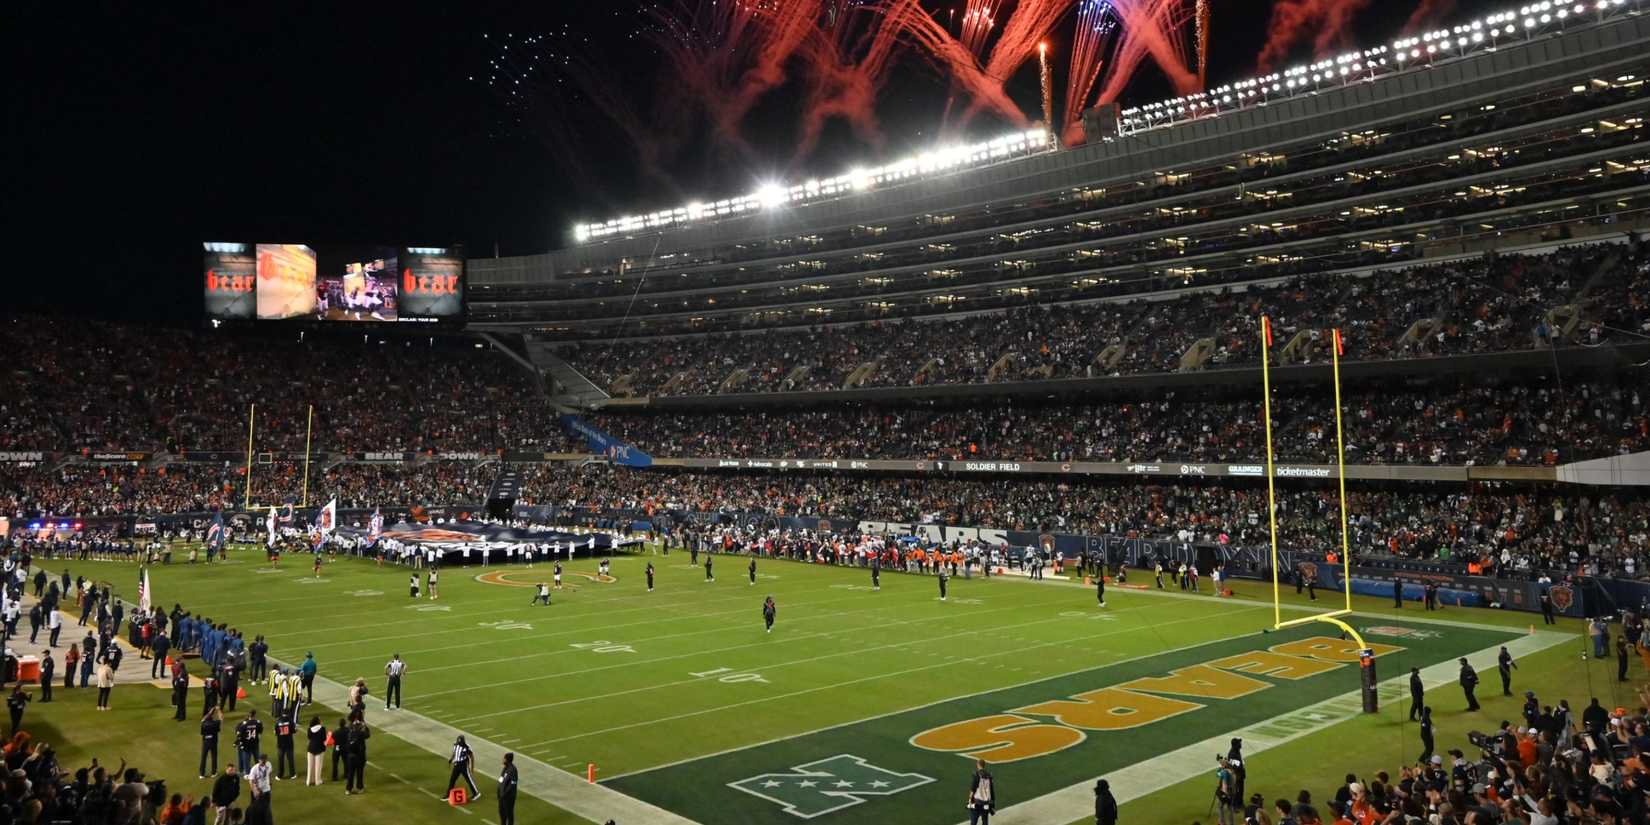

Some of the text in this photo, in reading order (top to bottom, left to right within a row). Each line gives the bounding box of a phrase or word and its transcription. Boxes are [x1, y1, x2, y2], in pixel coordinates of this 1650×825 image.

[364, 452, 403, 460] BEAR
[966, 463, 1020, 471] SOLDIER FIELD
[1189, 465, 1206, 474] PNC
[1276, 467, 1330, 477] ticketmaster
[909, 635, 1408, 764] BEARS
[245, 729, 257, 740] 34
[453, 789, 464, 803] G
